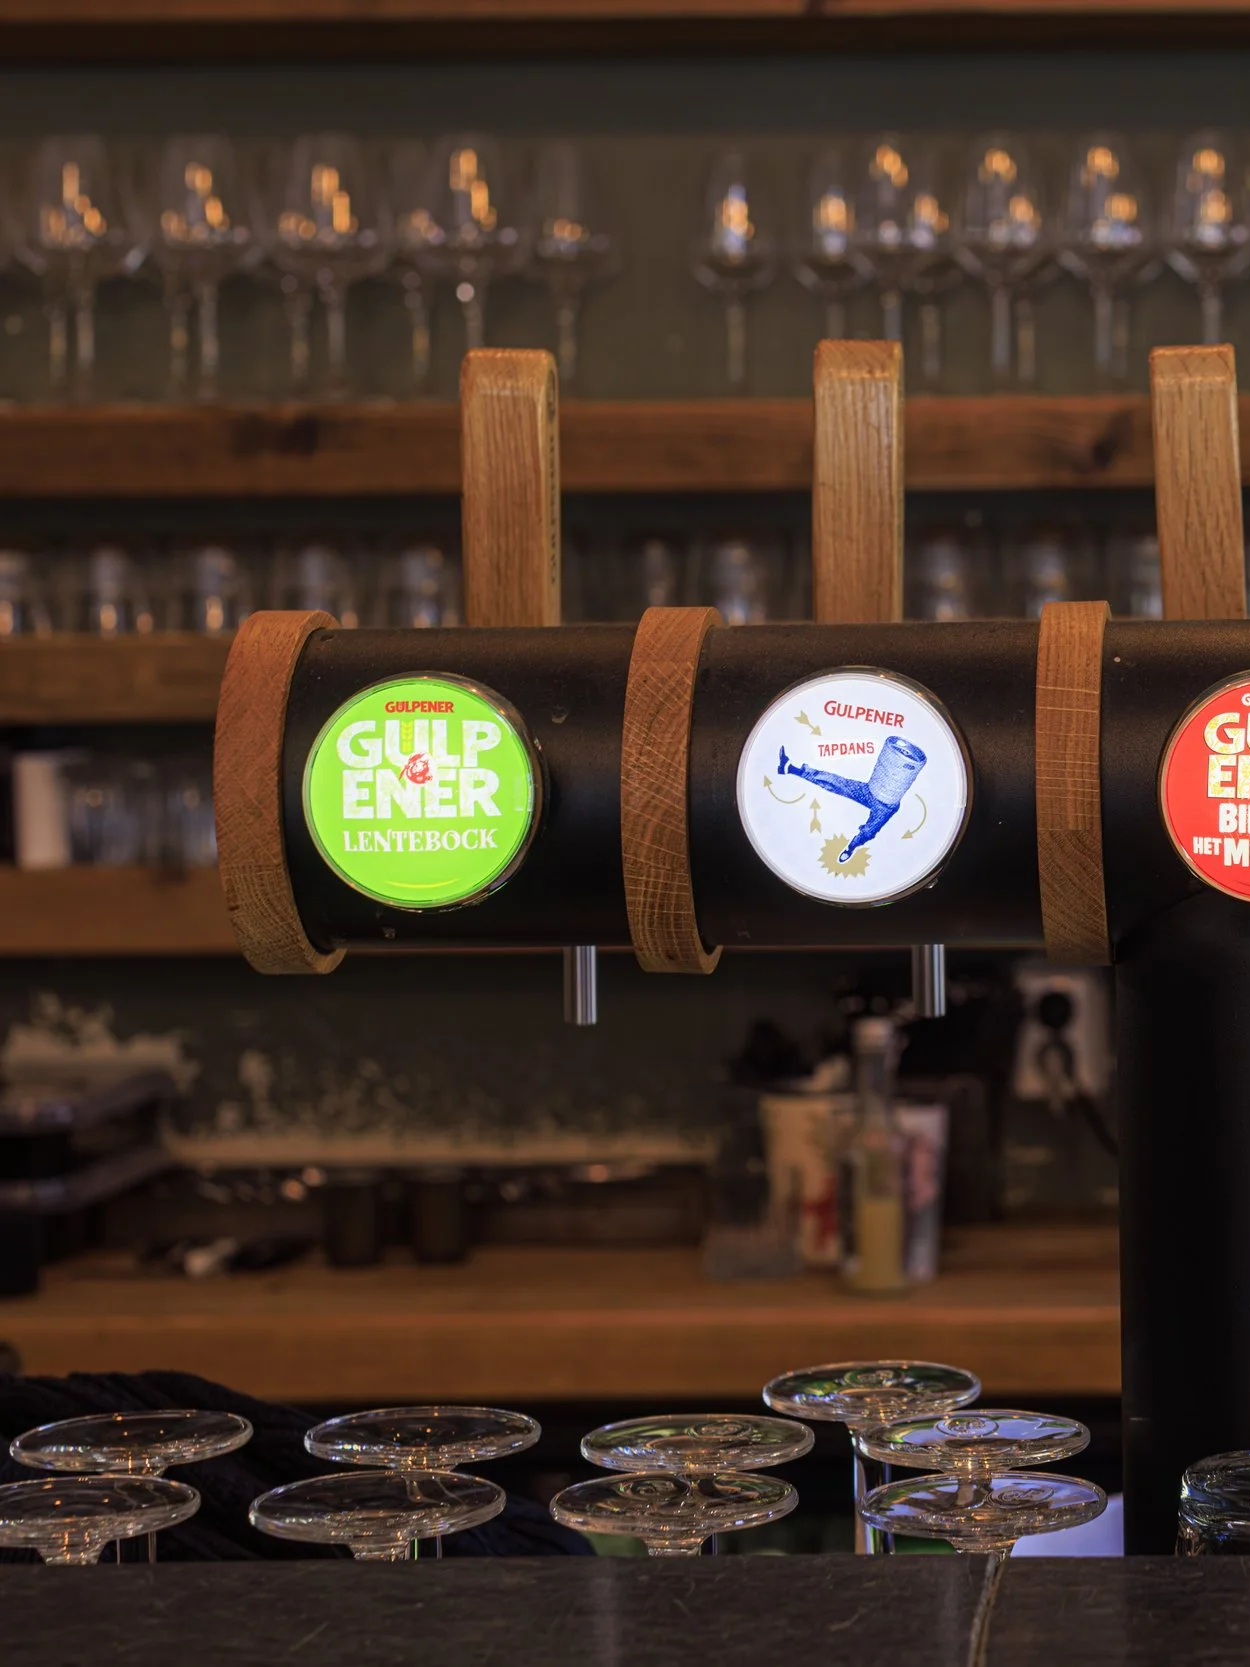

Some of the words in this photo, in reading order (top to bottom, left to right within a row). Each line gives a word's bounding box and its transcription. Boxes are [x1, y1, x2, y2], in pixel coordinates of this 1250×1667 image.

[385, 701, 454, 713] GULPENER
[824, 700, 905, 728] GULPENER
[336, 718, 502, 769] GULP
[818, 742, 875, 757] TAPDANS
[342, 768, 502, 820] ENER
[342, 828, 499, 852] LENTEBOCK
[1193, 836, 1222, 856] HET
